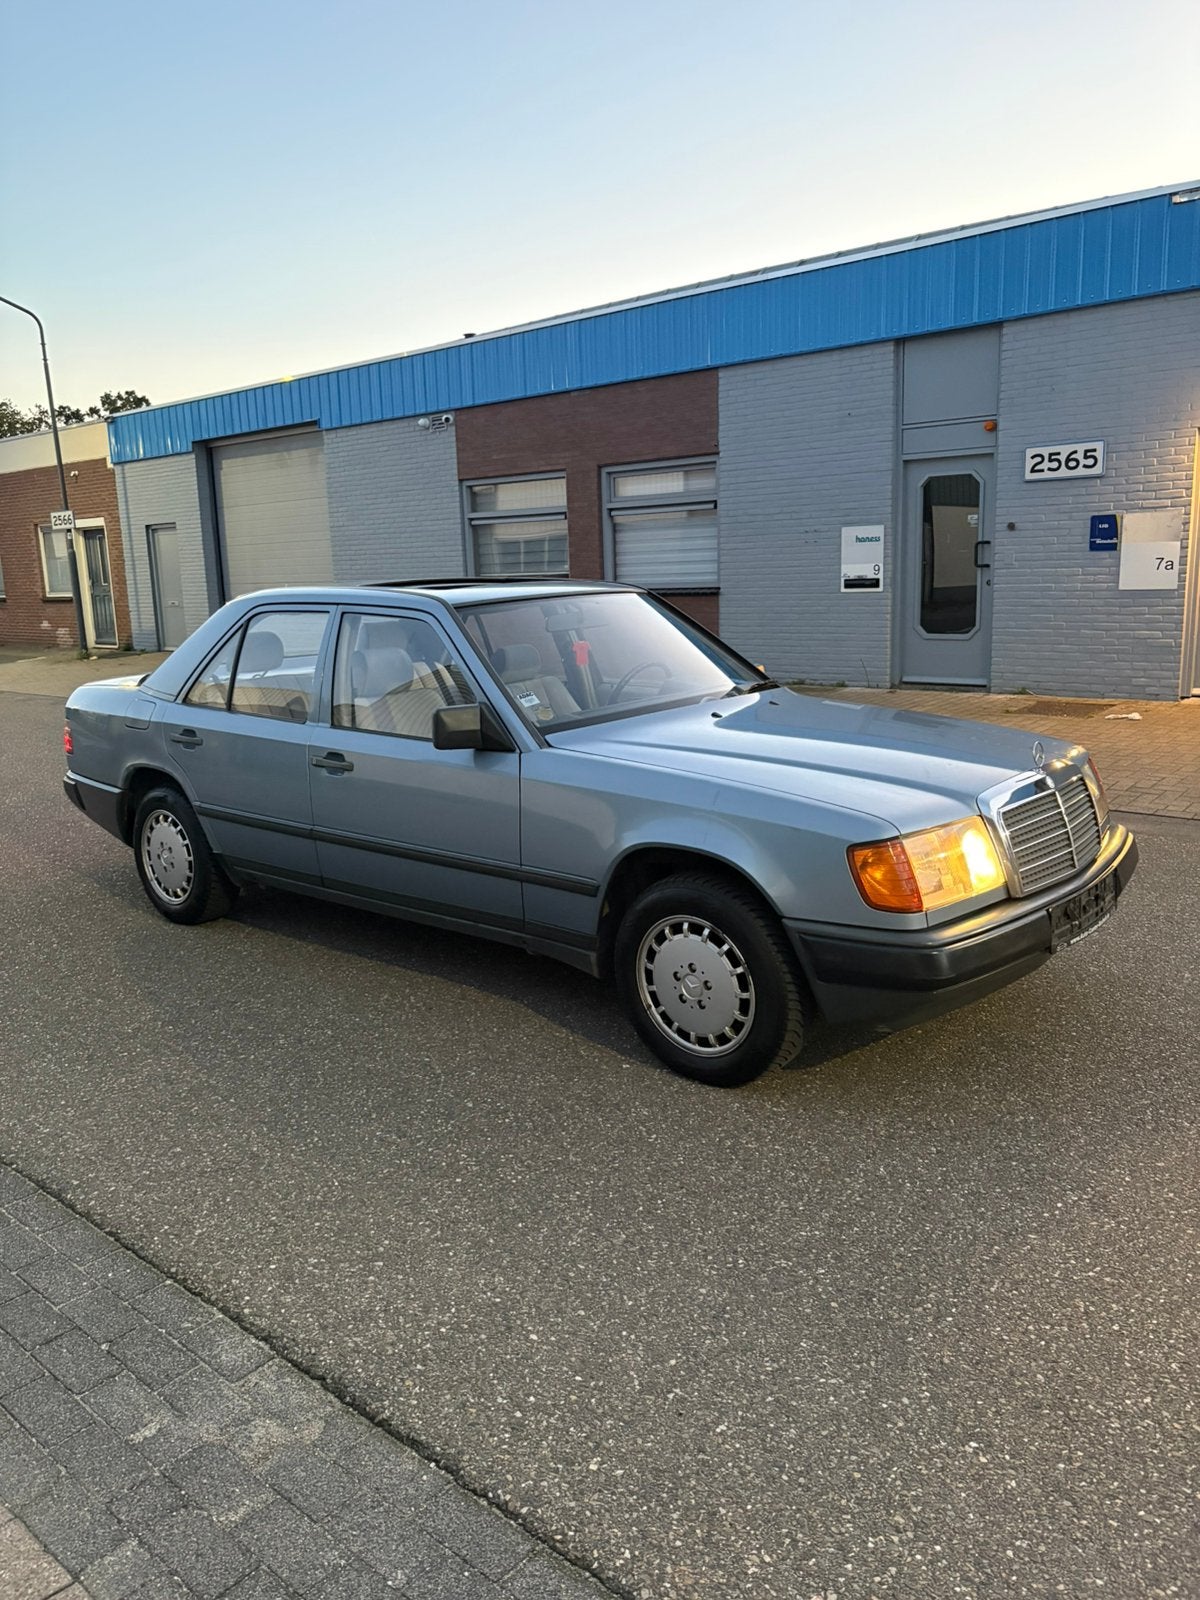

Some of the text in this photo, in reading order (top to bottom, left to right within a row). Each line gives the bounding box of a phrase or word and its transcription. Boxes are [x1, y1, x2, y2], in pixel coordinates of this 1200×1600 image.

[1030, 448, 1098, 474] 2565
[53, 514, 72, 526] 2566
[873, 564, 880, 576] 9
[1155, 557, 1174, 571] 7a
